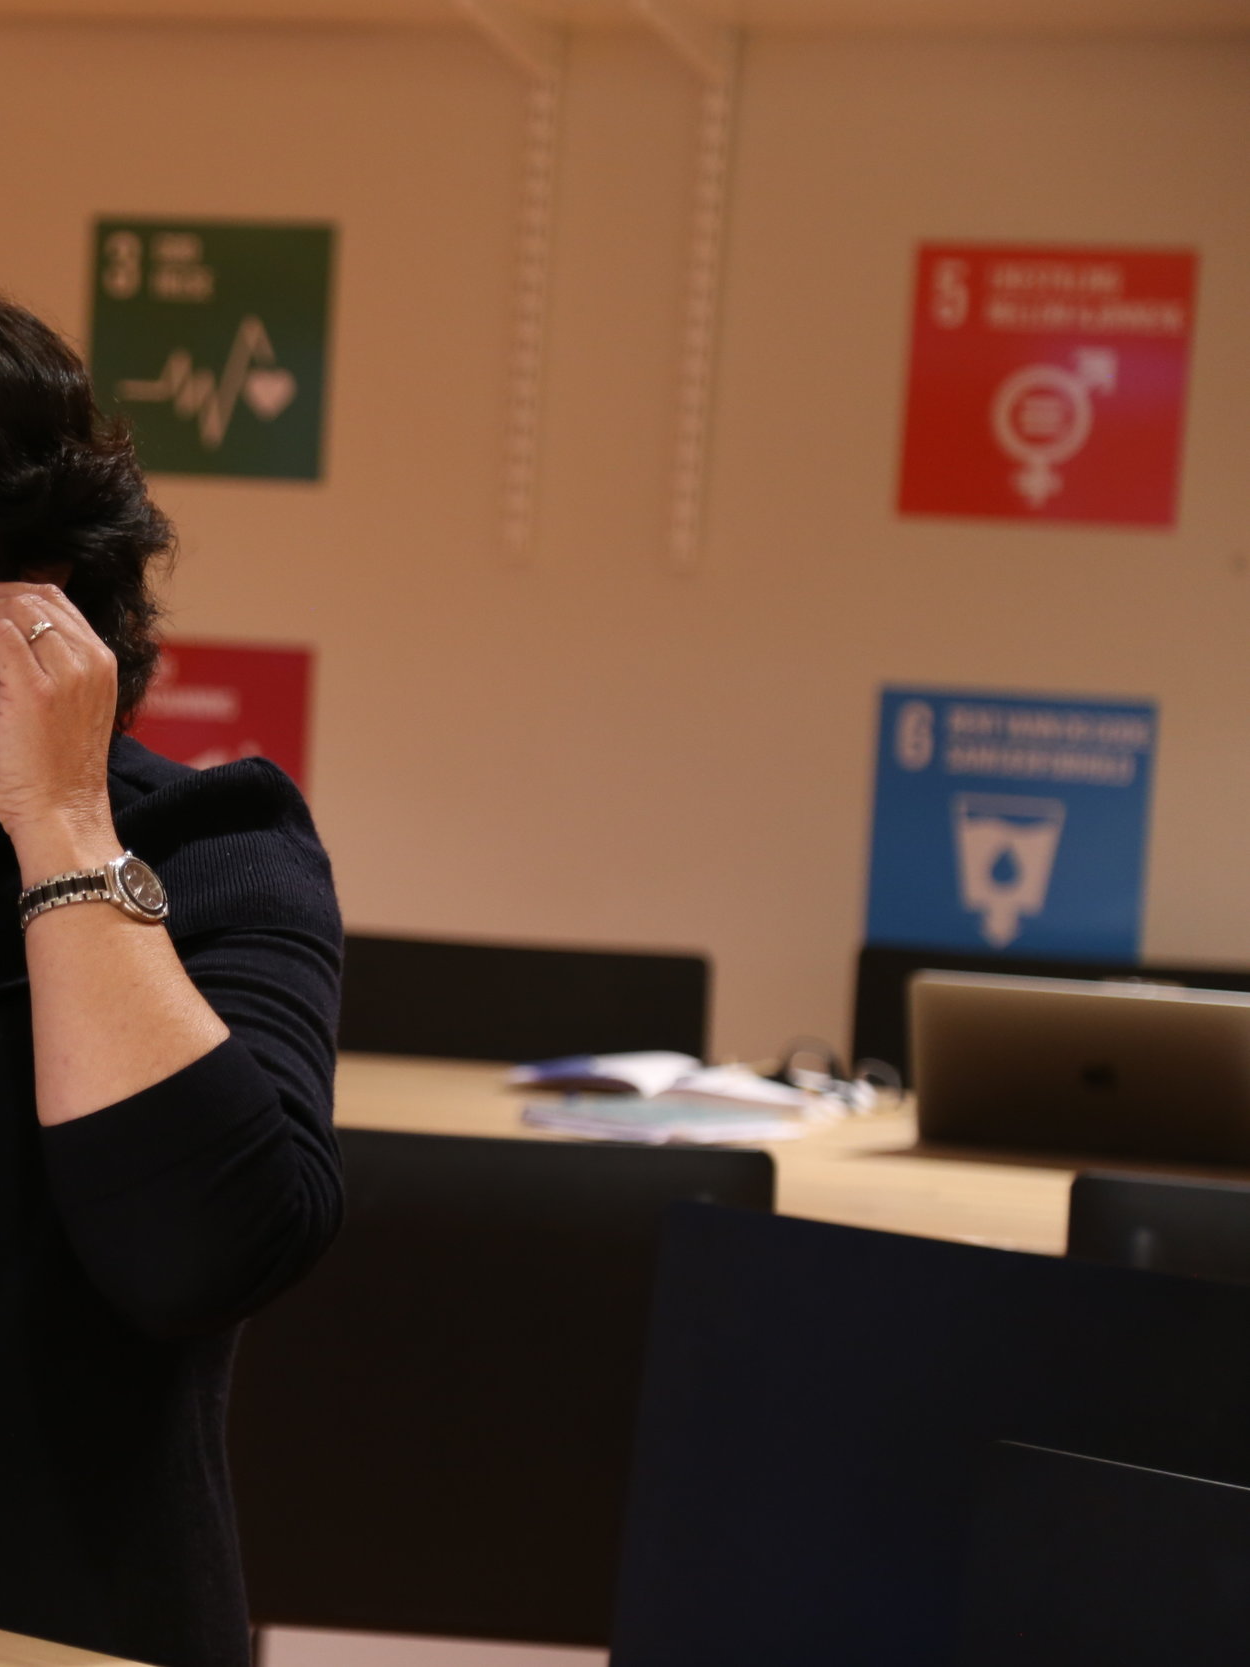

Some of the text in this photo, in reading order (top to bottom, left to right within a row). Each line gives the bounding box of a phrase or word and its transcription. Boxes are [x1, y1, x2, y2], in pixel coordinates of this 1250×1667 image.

[104, 231, 141, 299] 3
[932, 259, 970, 329] 5
[896, 700, 934, 771] 6
